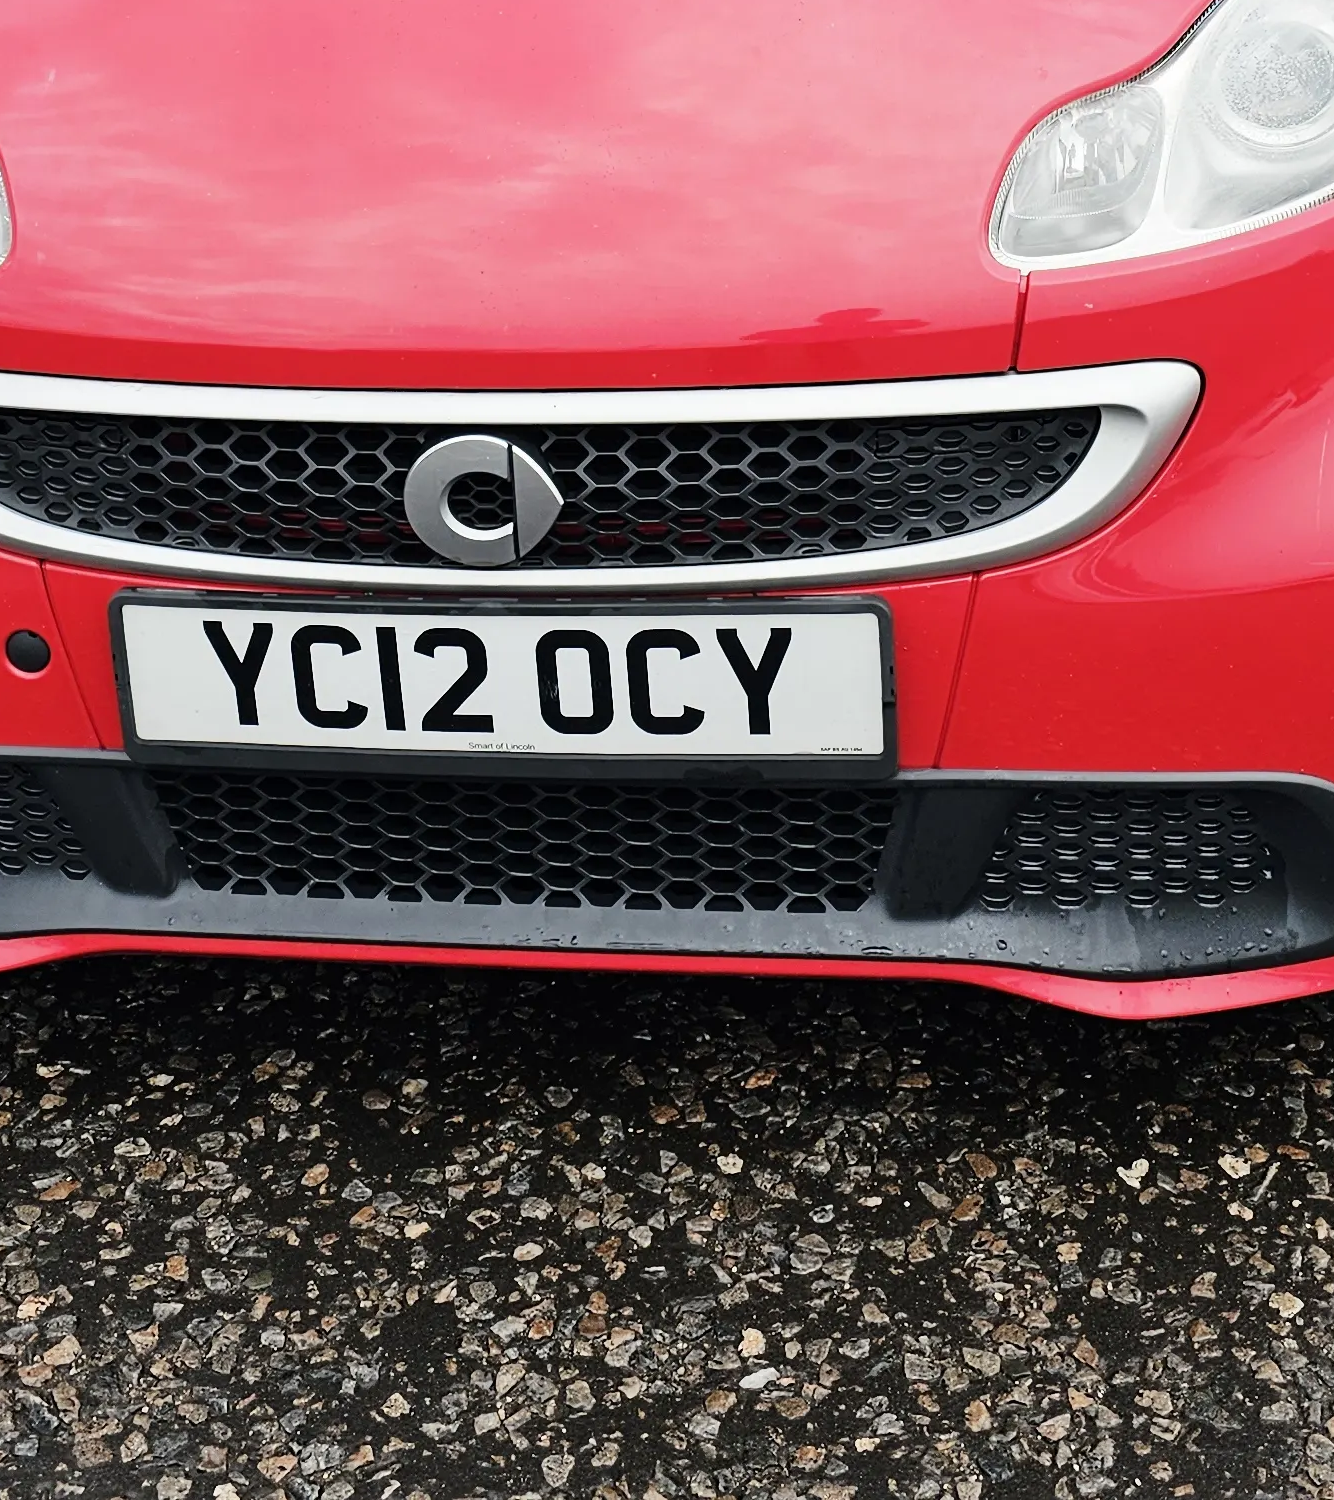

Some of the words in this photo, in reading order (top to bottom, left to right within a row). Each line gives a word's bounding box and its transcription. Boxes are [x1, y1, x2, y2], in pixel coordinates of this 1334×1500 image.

[202, 619, 495, 734] YC12
[535, 627, 793, 736] OCY
[468, 741, 493, 750] Smart
[495, 742, 505, 750] of
[505, 742, 536, 751] Lincoln
